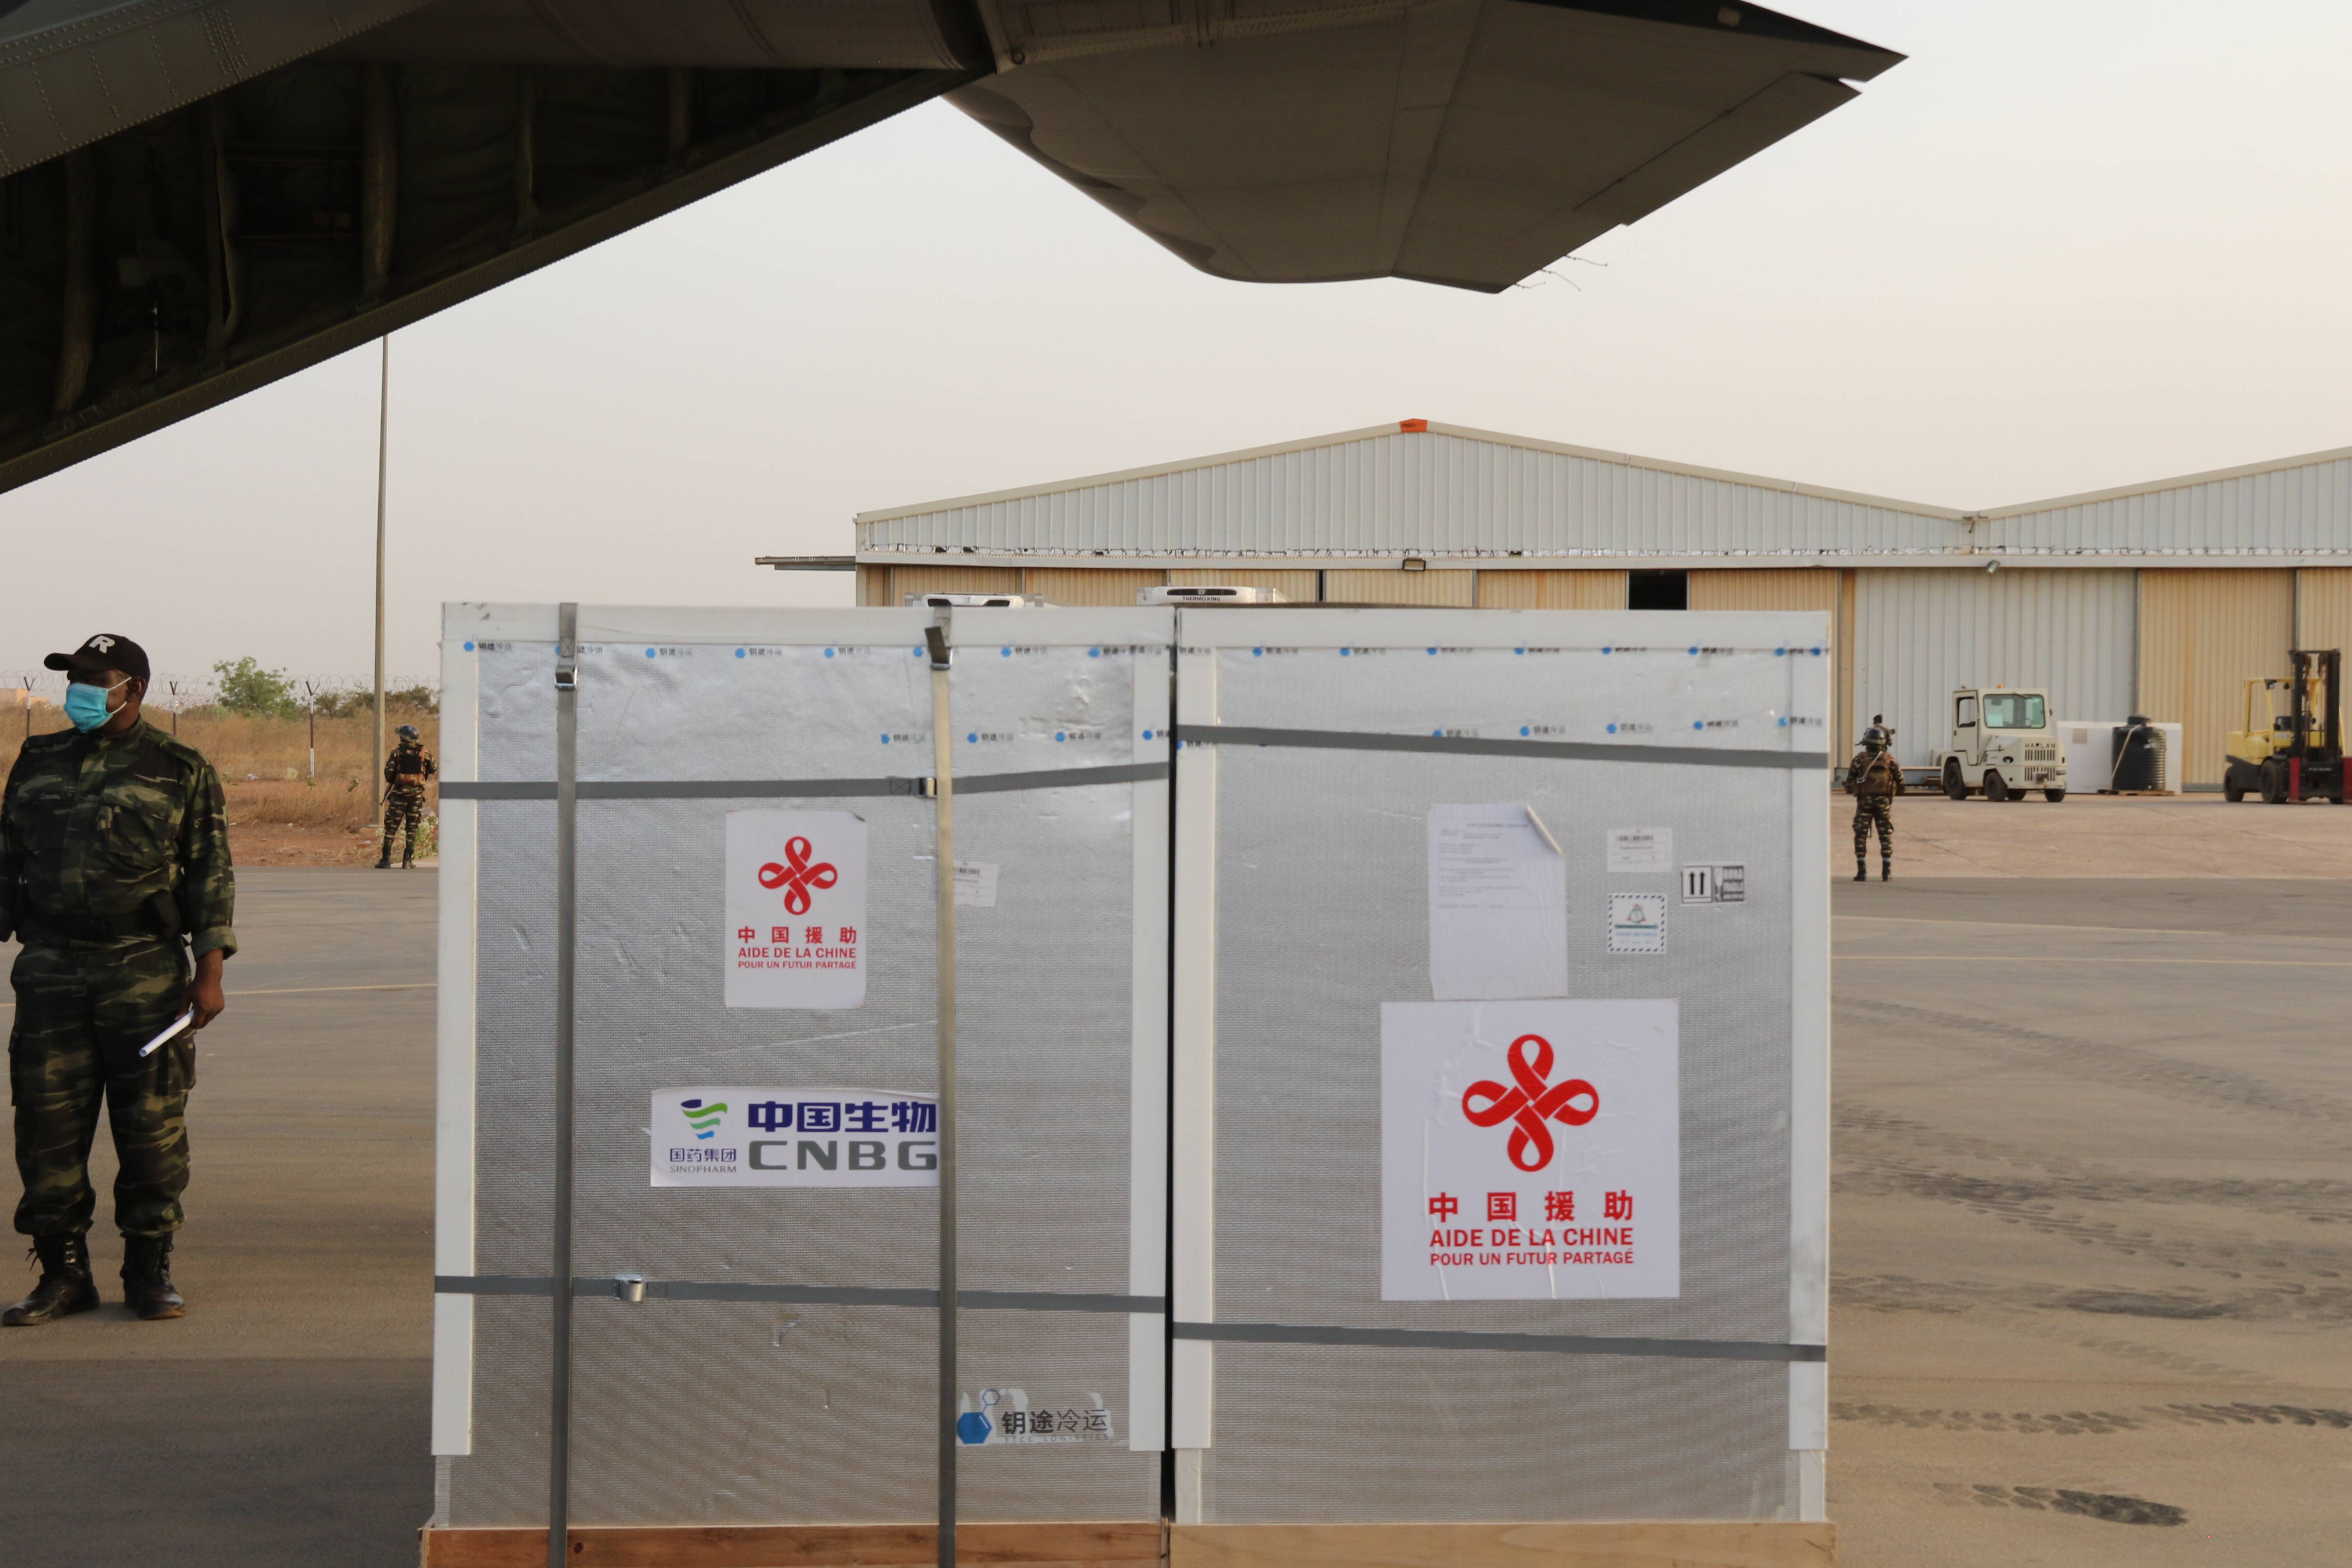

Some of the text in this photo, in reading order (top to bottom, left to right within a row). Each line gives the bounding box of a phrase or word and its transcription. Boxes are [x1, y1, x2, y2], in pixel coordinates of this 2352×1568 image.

[89, 635, 115, 653] R
[738, 926, 857, 944] 中国援助
[738, 947, 857, 959] AIDE DE LA CHINE
[738, 960, 857, 969] POUR UN FUTUR PARTAGÉ
[748, 1100, 937, 1133] 中国生物
[670, 1148, 737, 1163] 国药集团
[749, 1140, 937, 1170] CNBG
[670, 1165, 737, 1173] SINOPHARM
[1429, 1189, 1634, 1222] 中国援助
[1430, 1227, 1634, 1247] AIDE DE LA CHINE
[1430, 1249, 1634, 1266] POUR UN FUTUR PARTAGÉ
[1001, 1409, 1108, 1435] 钥途冷运
